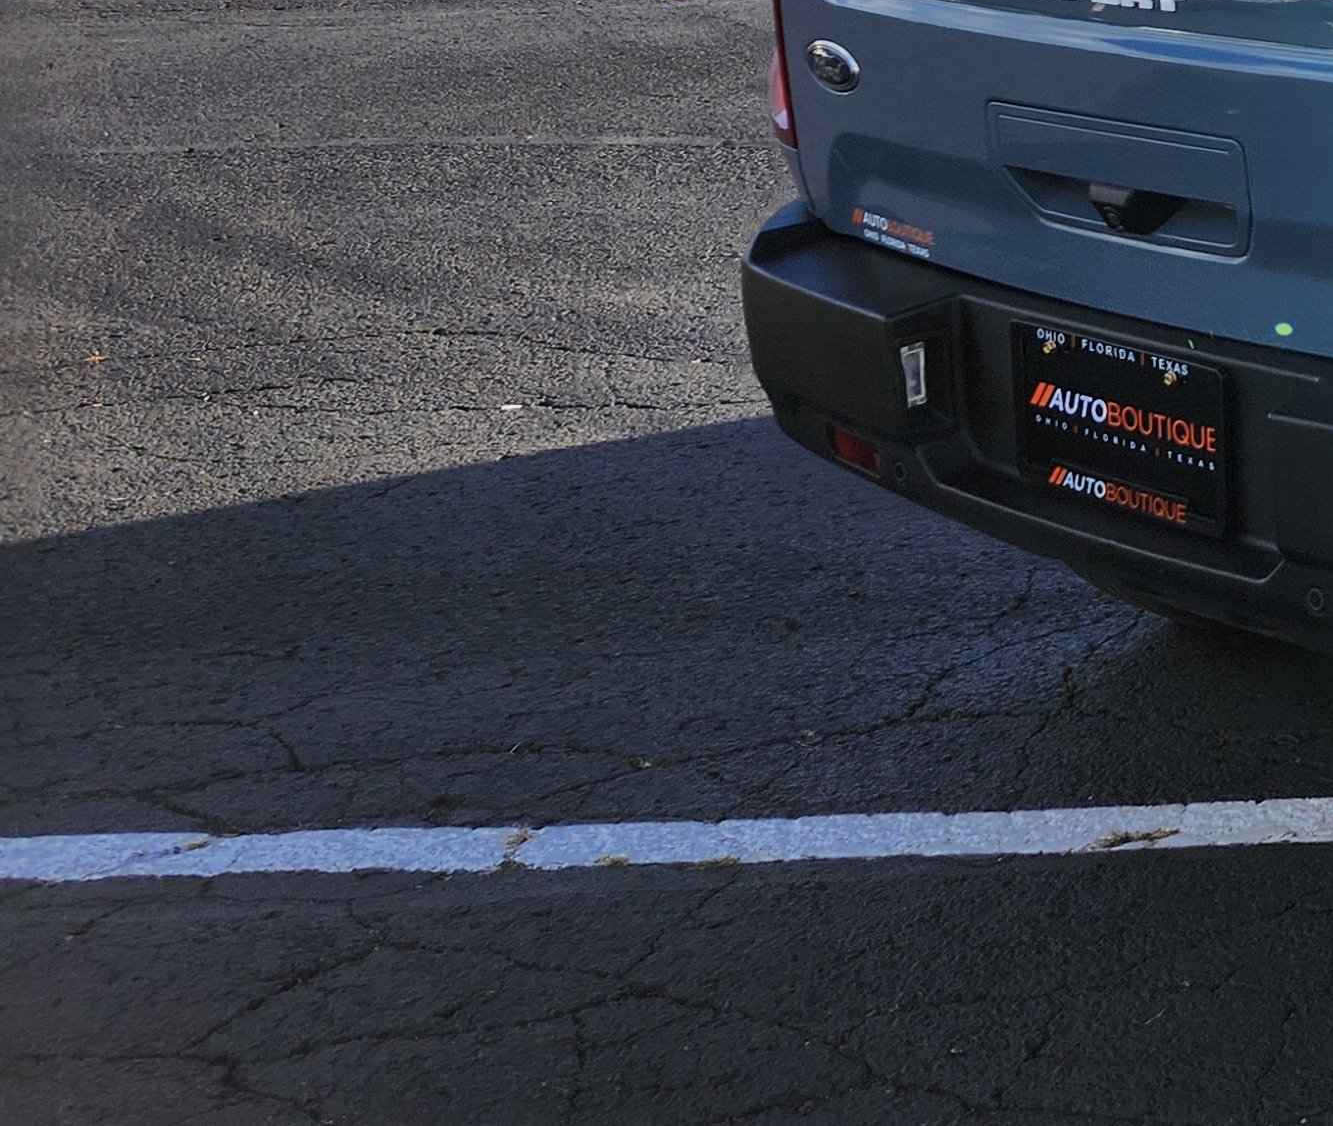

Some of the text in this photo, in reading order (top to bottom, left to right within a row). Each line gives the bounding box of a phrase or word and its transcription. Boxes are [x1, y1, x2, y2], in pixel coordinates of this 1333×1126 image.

[1036, 327, 1189, 376] OHIO FLORIDA TEXAS
[1035, 413, 1216, 471] OHIO FLORIDA TEXAS
